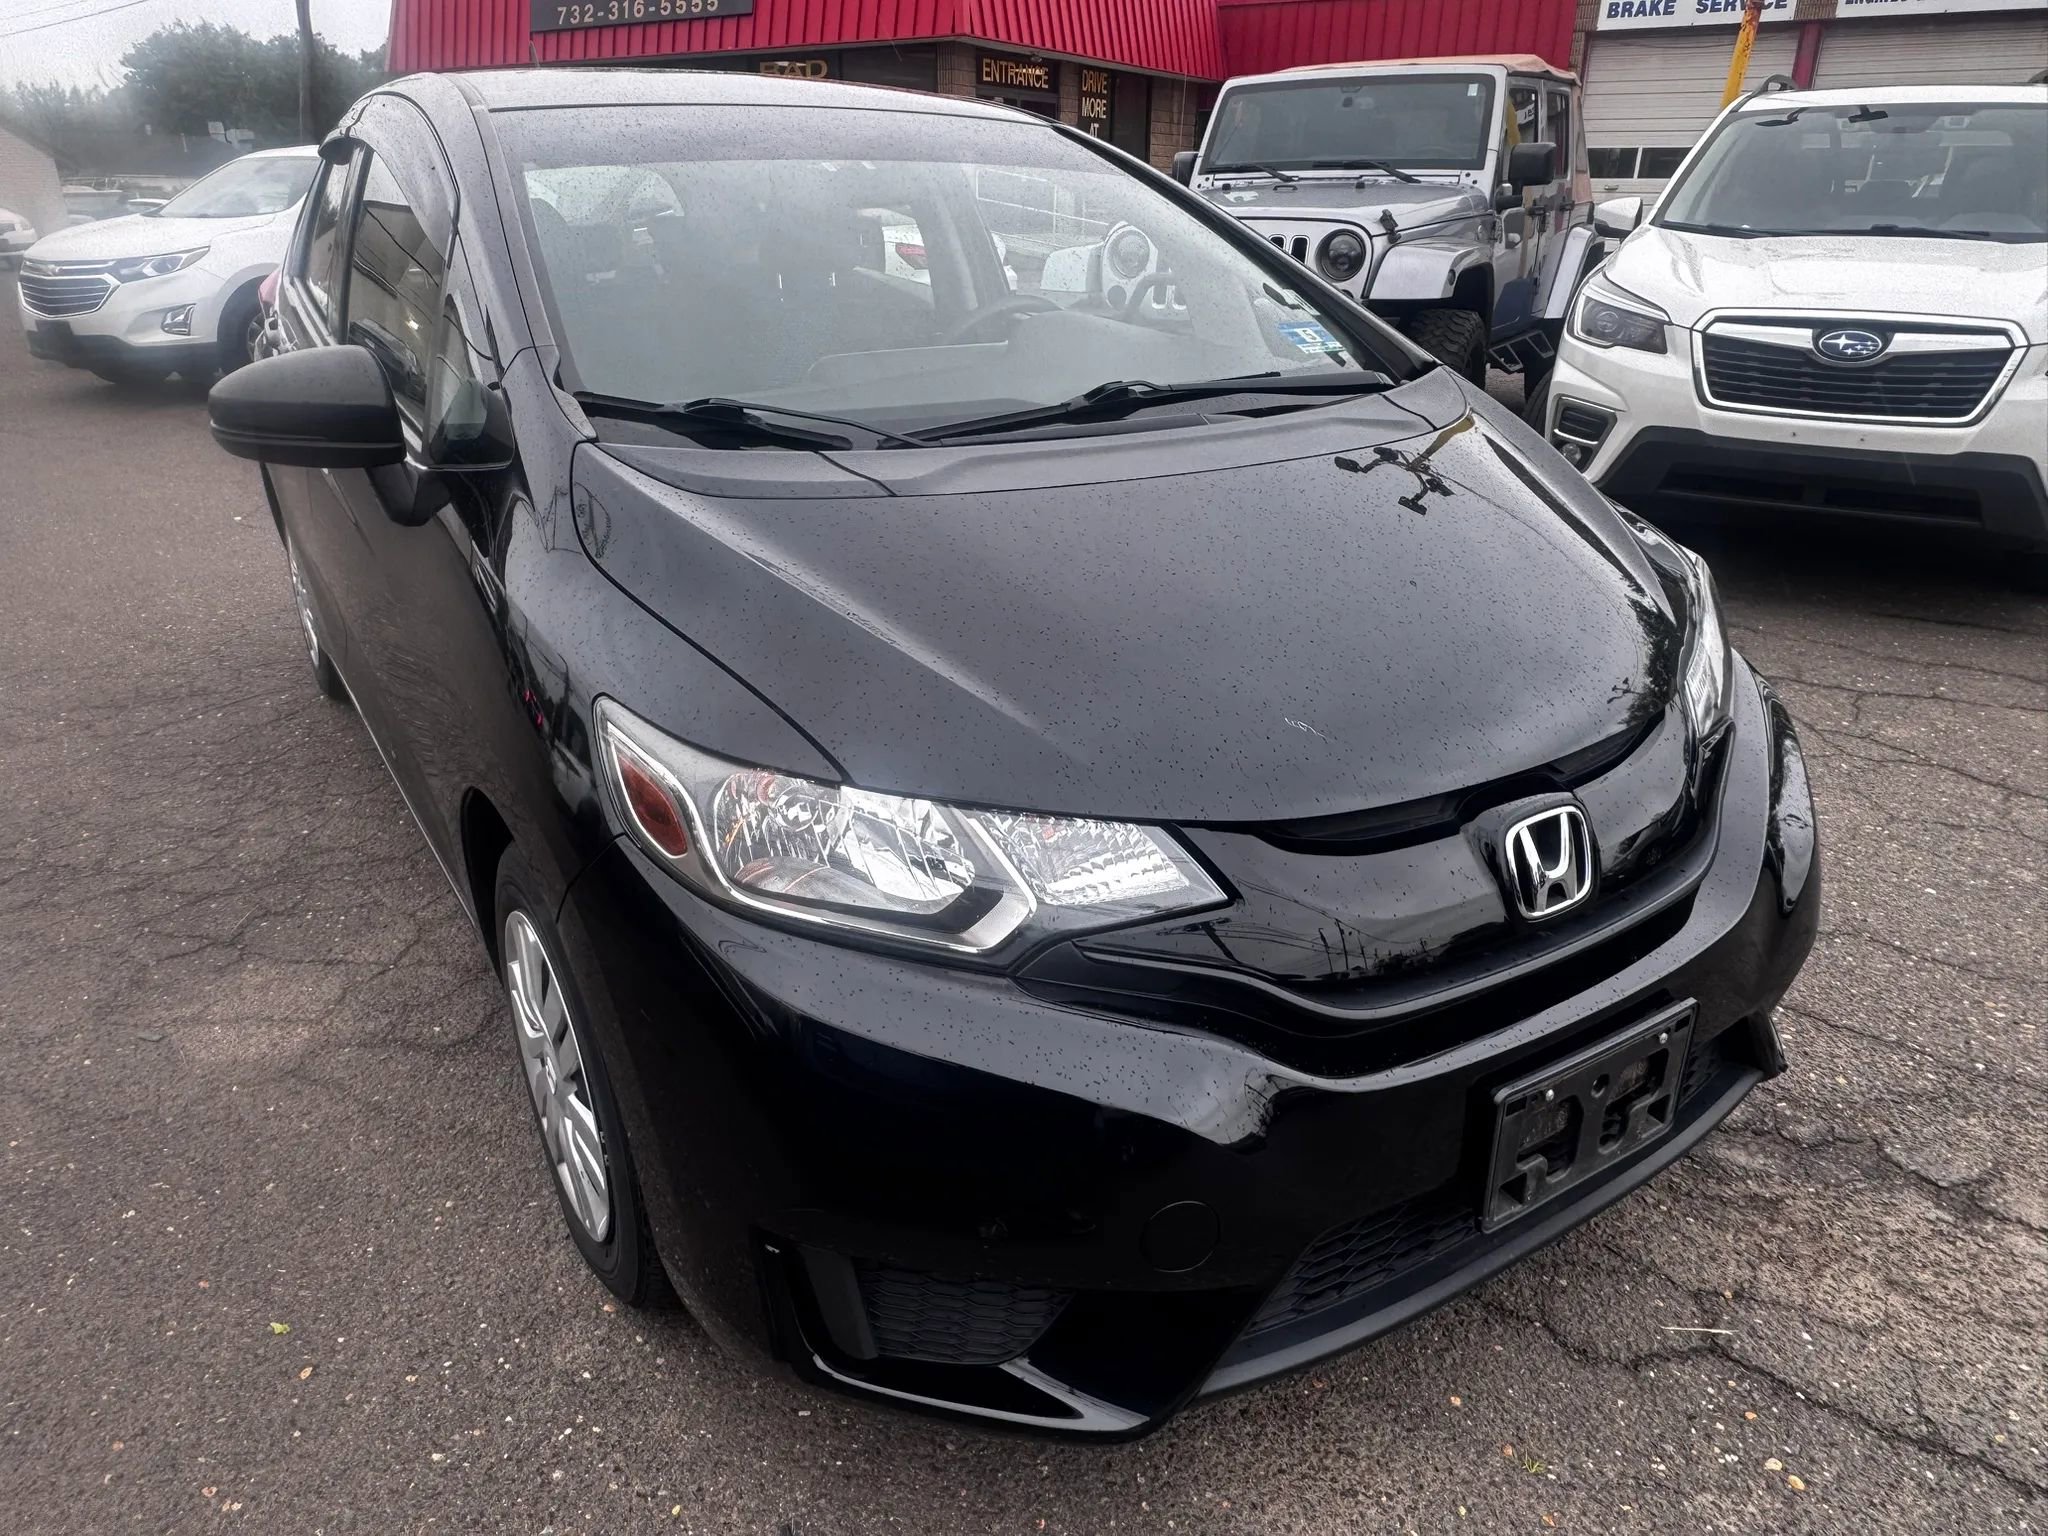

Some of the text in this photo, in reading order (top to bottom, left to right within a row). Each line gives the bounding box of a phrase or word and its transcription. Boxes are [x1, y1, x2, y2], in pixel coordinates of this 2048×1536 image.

[557, 0, 718, 25] 732-316-5555
[1607, 0, 1676, 18] BRAKE
[982, 58, 1049, 88] ENTRANCE
[1082, 69, 1107, 94] DRIVE
[1082, 96, 1106, 118] MORE
[1089, 123, 1099, 138] AT
